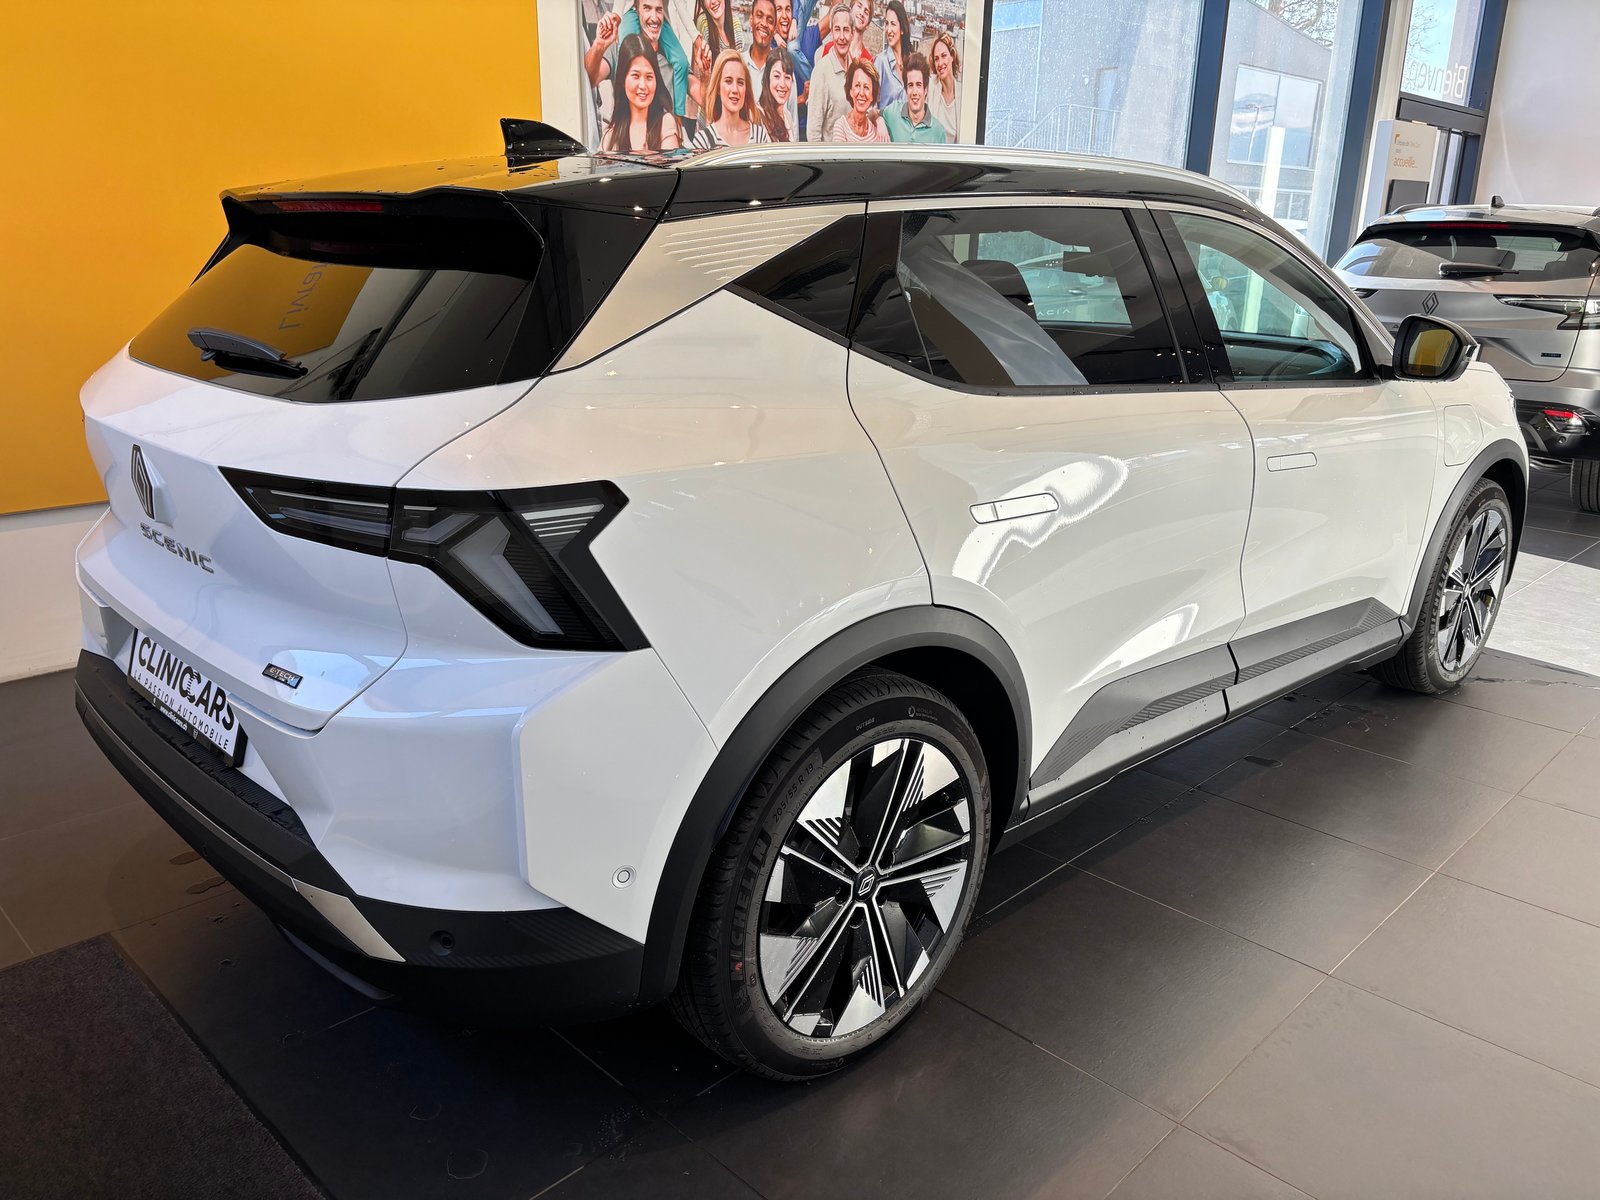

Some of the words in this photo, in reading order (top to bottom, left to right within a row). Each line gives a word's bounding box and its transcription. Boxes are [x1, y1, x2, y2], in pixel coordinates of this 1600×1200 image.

[140, 521, 214, 575] SCENIC
[133, 668, 142, 681] LA
[143, 677, 175, 709] PASSION
[176, 704, 229, 750] AUTOMOBILE
[773, 783, 798, 824] 205/55
[798, 774, 805, 785] R
[805, 763, 814, 776] 19
[729, 831, 773, 982] MICHELIN
